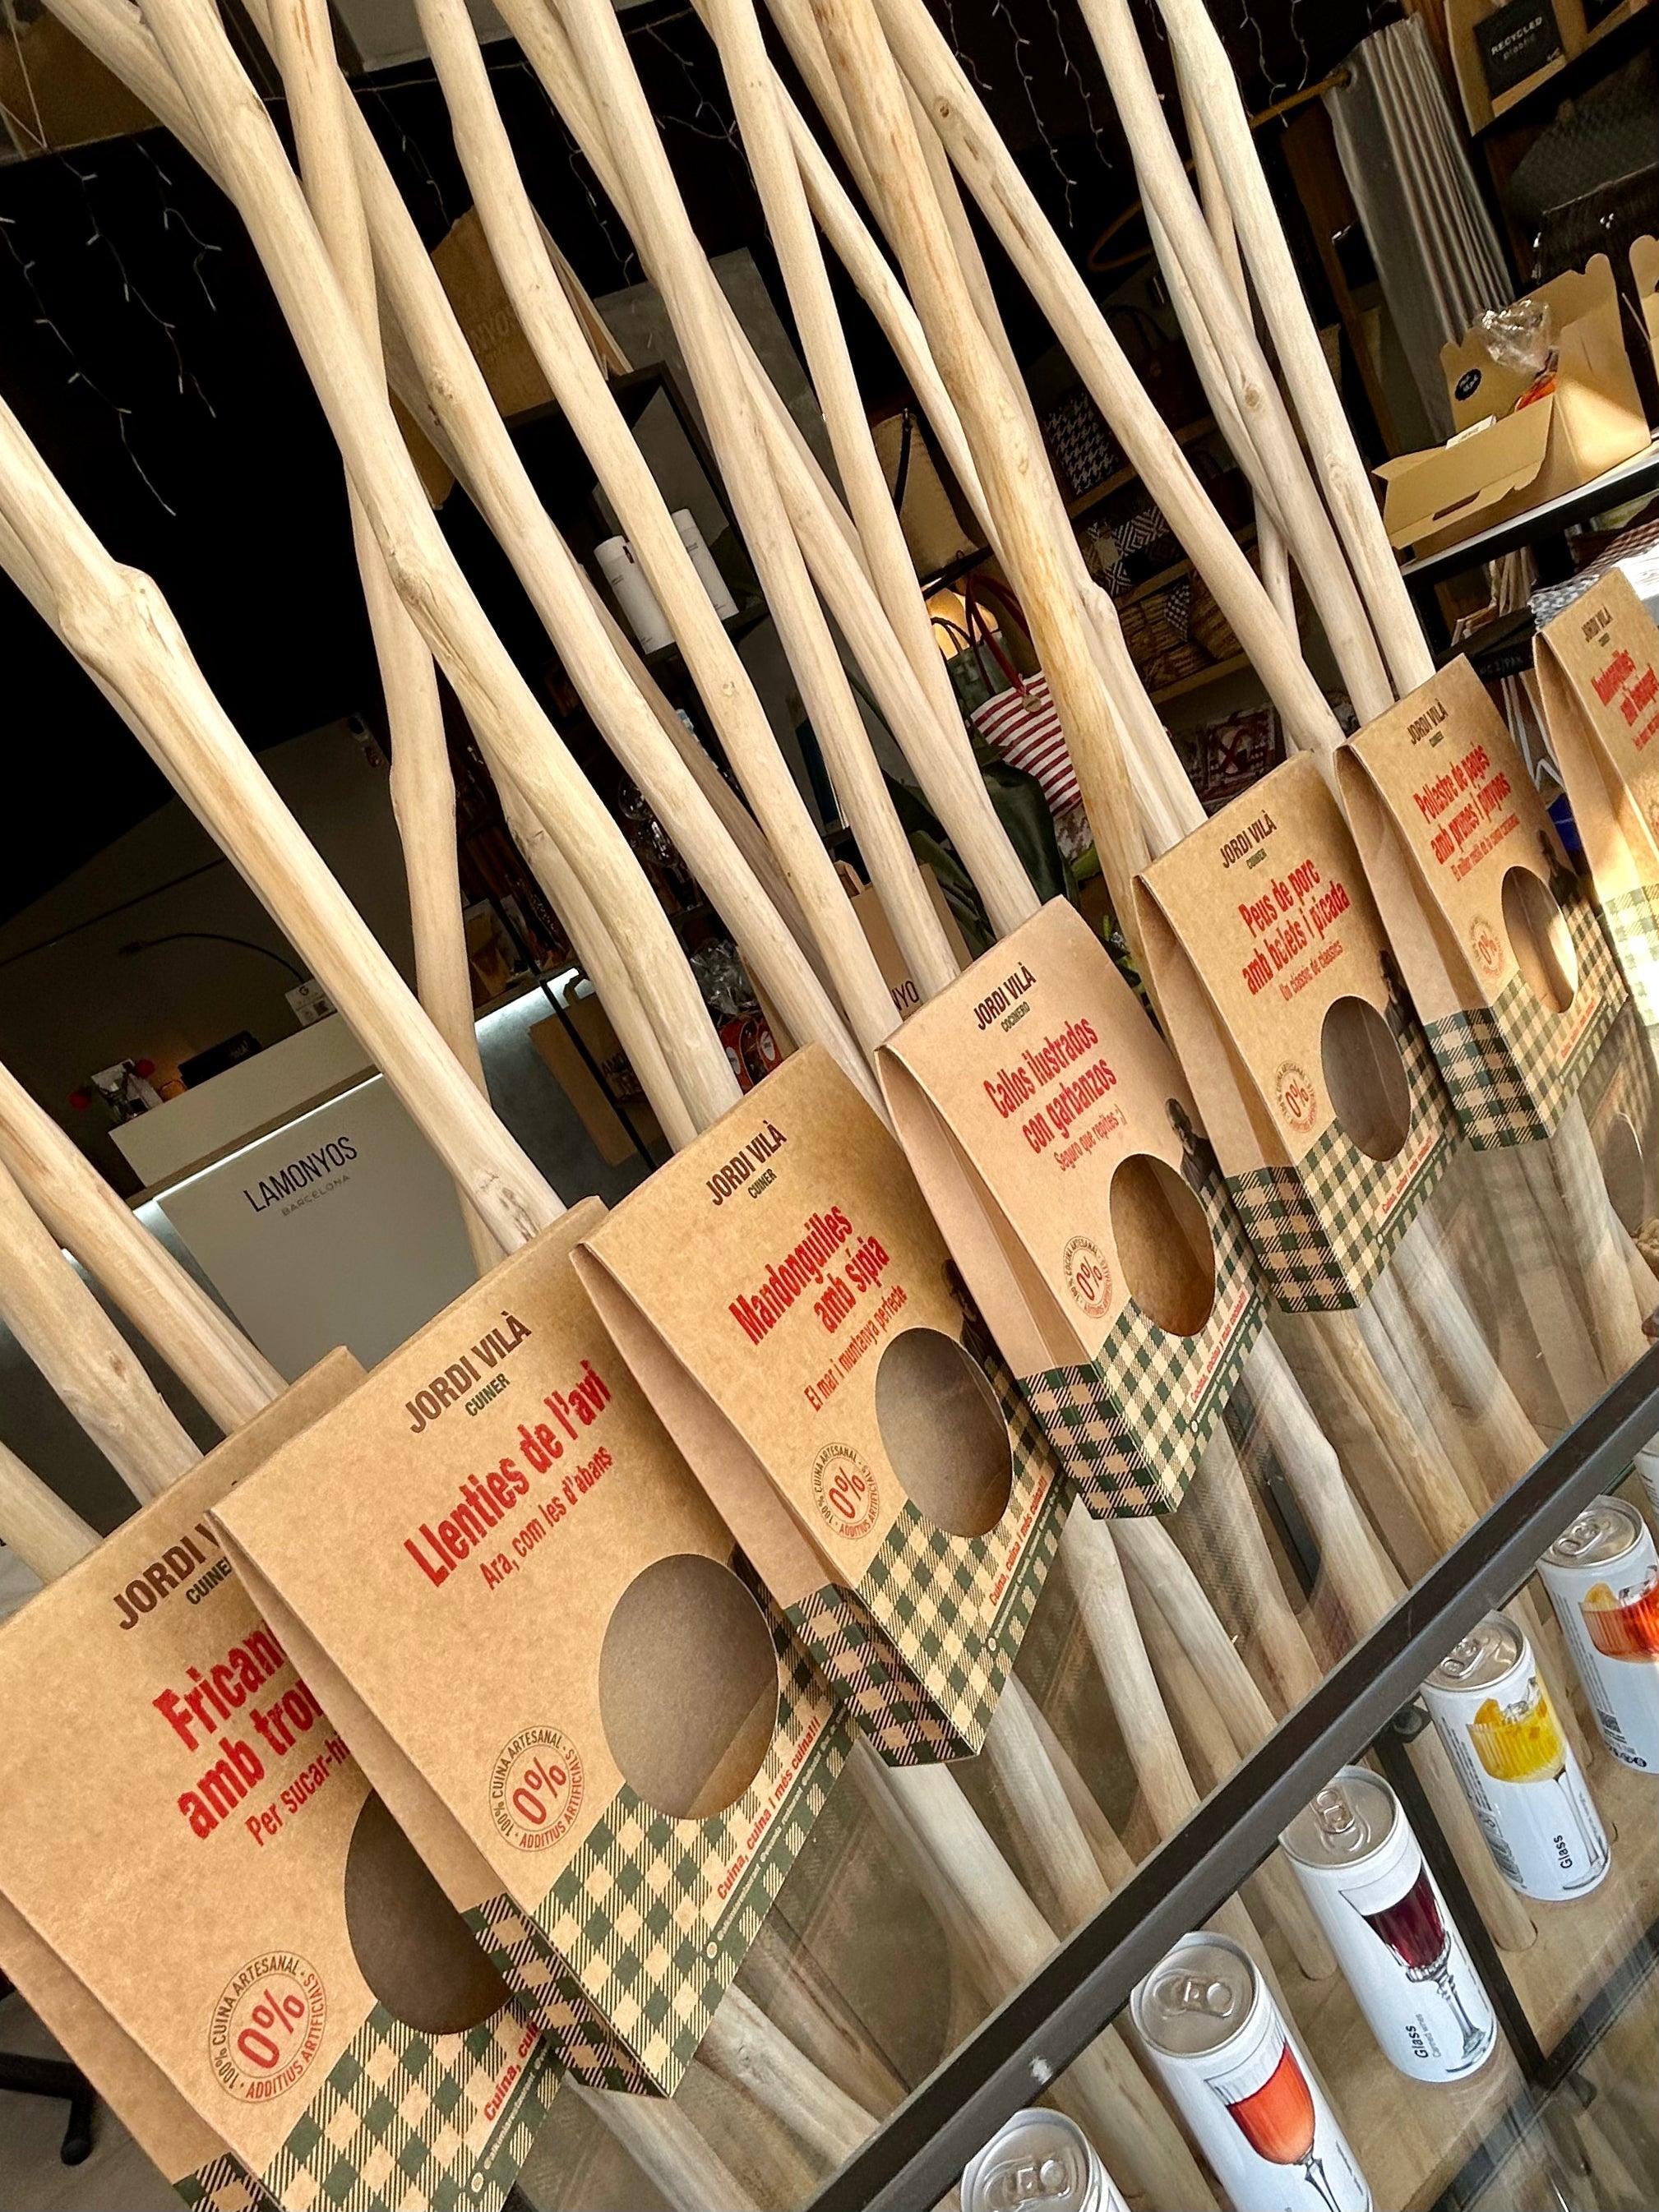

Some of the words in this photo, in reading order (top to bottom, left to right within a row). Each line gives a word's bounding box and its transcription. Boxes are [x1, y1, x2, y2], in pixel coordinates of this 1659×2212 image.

[1491, 16, 1543, 55] RECYCLED
[1407, 710, 1432, 746] JORDI
[1429, 698, 1449, 727] VILÀ
[1413, 774, 1459, 824] Pollastre
[1449, 761, 1468, 792] de
[1220, 830, 1253, 868] JORDI
[1250, 809, 1278, 843] VILÀ
[1430, 823, 1456, 865] amb
[1238, 894, 1278, 939] Peus
[1271, 878, 1295, 912] de
[1287, 859, 1320, 906] porc
[1242, 948, 1273, 995] amb
[1264, 919, 1307, 972] bolets
[1300, 907, 1315, 940] i
[1310, 880, 1351, 940] picada
[973, 991, 1010, 1030] JORDI
[1003, 962, 1037, 1000] VILÀ
[983, 1068, 1036, 1118] Callos
[1022, 1018, 1098, 1087] ilustrados
[1285, 1078, 1309, 1118] 0%
[1022, 1112, 1055, 1154] con
[1046, 1059, 1117, 1138] garbanzos
[243, 1136, 358, 1212] LAMONYOS
[705, 1150, 755, 1207] JORDI
[746, 1120, 787, 1172] VILÀ
[1054, 1141, 1084, 1171] Seguro
[1079, 1129, 1097, 1154] que
[281, 1175, 351, 1217] BARCELONA
[747, 1168, 777, 1199] CUINER
[728, 1205, 853, 1346] Mandonguilles
[813, 1272, 857, 1333] amb
[845, 1236, 890, 1293] sípia
[1076, 1255, 1102, 1300] 0%
[405, 1355, 482, 1434] JORDI
[470, 1310, 533, 1369] VILÀ
[803, 1385, 823, 1412] El
[819, 1368, 839, 1400] mar
[830, 1359, 845, 1379] i
[838, 1318, 880, 1374] muntanya
[874, 1285, 908, 1333] perfecte
[464, 1373, 511, 1417] CUINER
[403, 1457, 530, 1587] Llenties
[517, 1423, 564, 1474] de
[543, 1360, 612, 1440] l'avi
[829, 1466, 866, 1519] 0%
[479, 1553, 520, 1591] Ara,
[511, 1517, 547, 1558] com
[537, 1496, 566, 1527] les
[561, 1446, 613, 1505] d'abans
[113, 1535, 206, 1630] JORDI
[186, 1556, 233, 1605] CUINE
[988, 1572, 1010, 1607] Cuina,
[1005, 1541, 1022, 1572] cuina
[506, 1729, 562, 1759] ARTESANAL
[178, 1736, 266, 1840] amb
[492, 1757, 511, 1799] CUINA
[512, 1757, 566, 1825] 0%
[519, 1820, 566, 1849] ADDITIUS
[564, 1748, 582, 1825] ARTIFICIALS
[717, 1854, 750, 1900] Cuina,
[746, 1808, 772, 1850] cuina
[774, 1771, 793, 1799] més
[791, 1716, 822, 1770] cuina!!!
[244, 1802, 283, 1847] Per
[493, 1801, 514, 1837] 100%
[1554, 1835, 1574, 1869] Glass
[232, 1955, 299, 1997] ARTESANAL
[212, 1995, 237, 2046] CUINA
[238, 1988, 305, 2069] 0%
[245, 2059, 303, 2099] ADDITIUS
[301, 1973, 325, 2064] ARTIFICIALS
[1405, 2025, 1429, 2058] Glass
[214, 2048, 239, 2090] 100%
[483, 2064, 521, 2122] Cuina,
